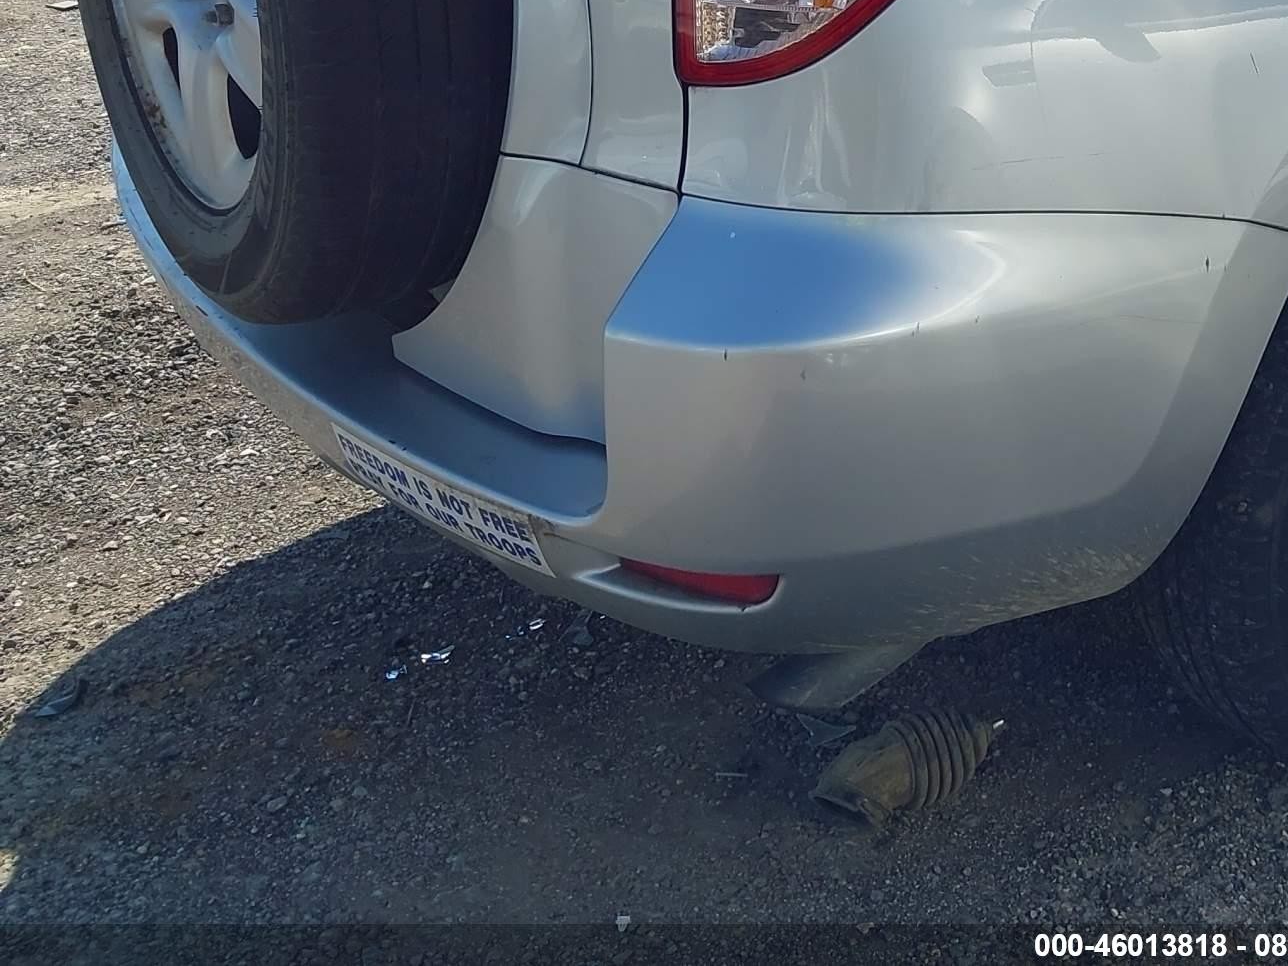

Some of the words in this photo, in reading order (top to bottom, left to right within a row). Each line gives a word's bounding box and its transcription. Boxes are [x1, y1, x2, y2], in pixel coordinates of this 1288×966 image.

[338, 434, 411, 490] FREEDOM
[413, 477, 433, 501] IS
[436, 488, 473, 520] NOT
[478, 507, 533, 543] FREE
[388, 482, 424, 512] FOR
[425, 502, 464, 533] OUR
[464, 521, 542, 566] TROOPS
